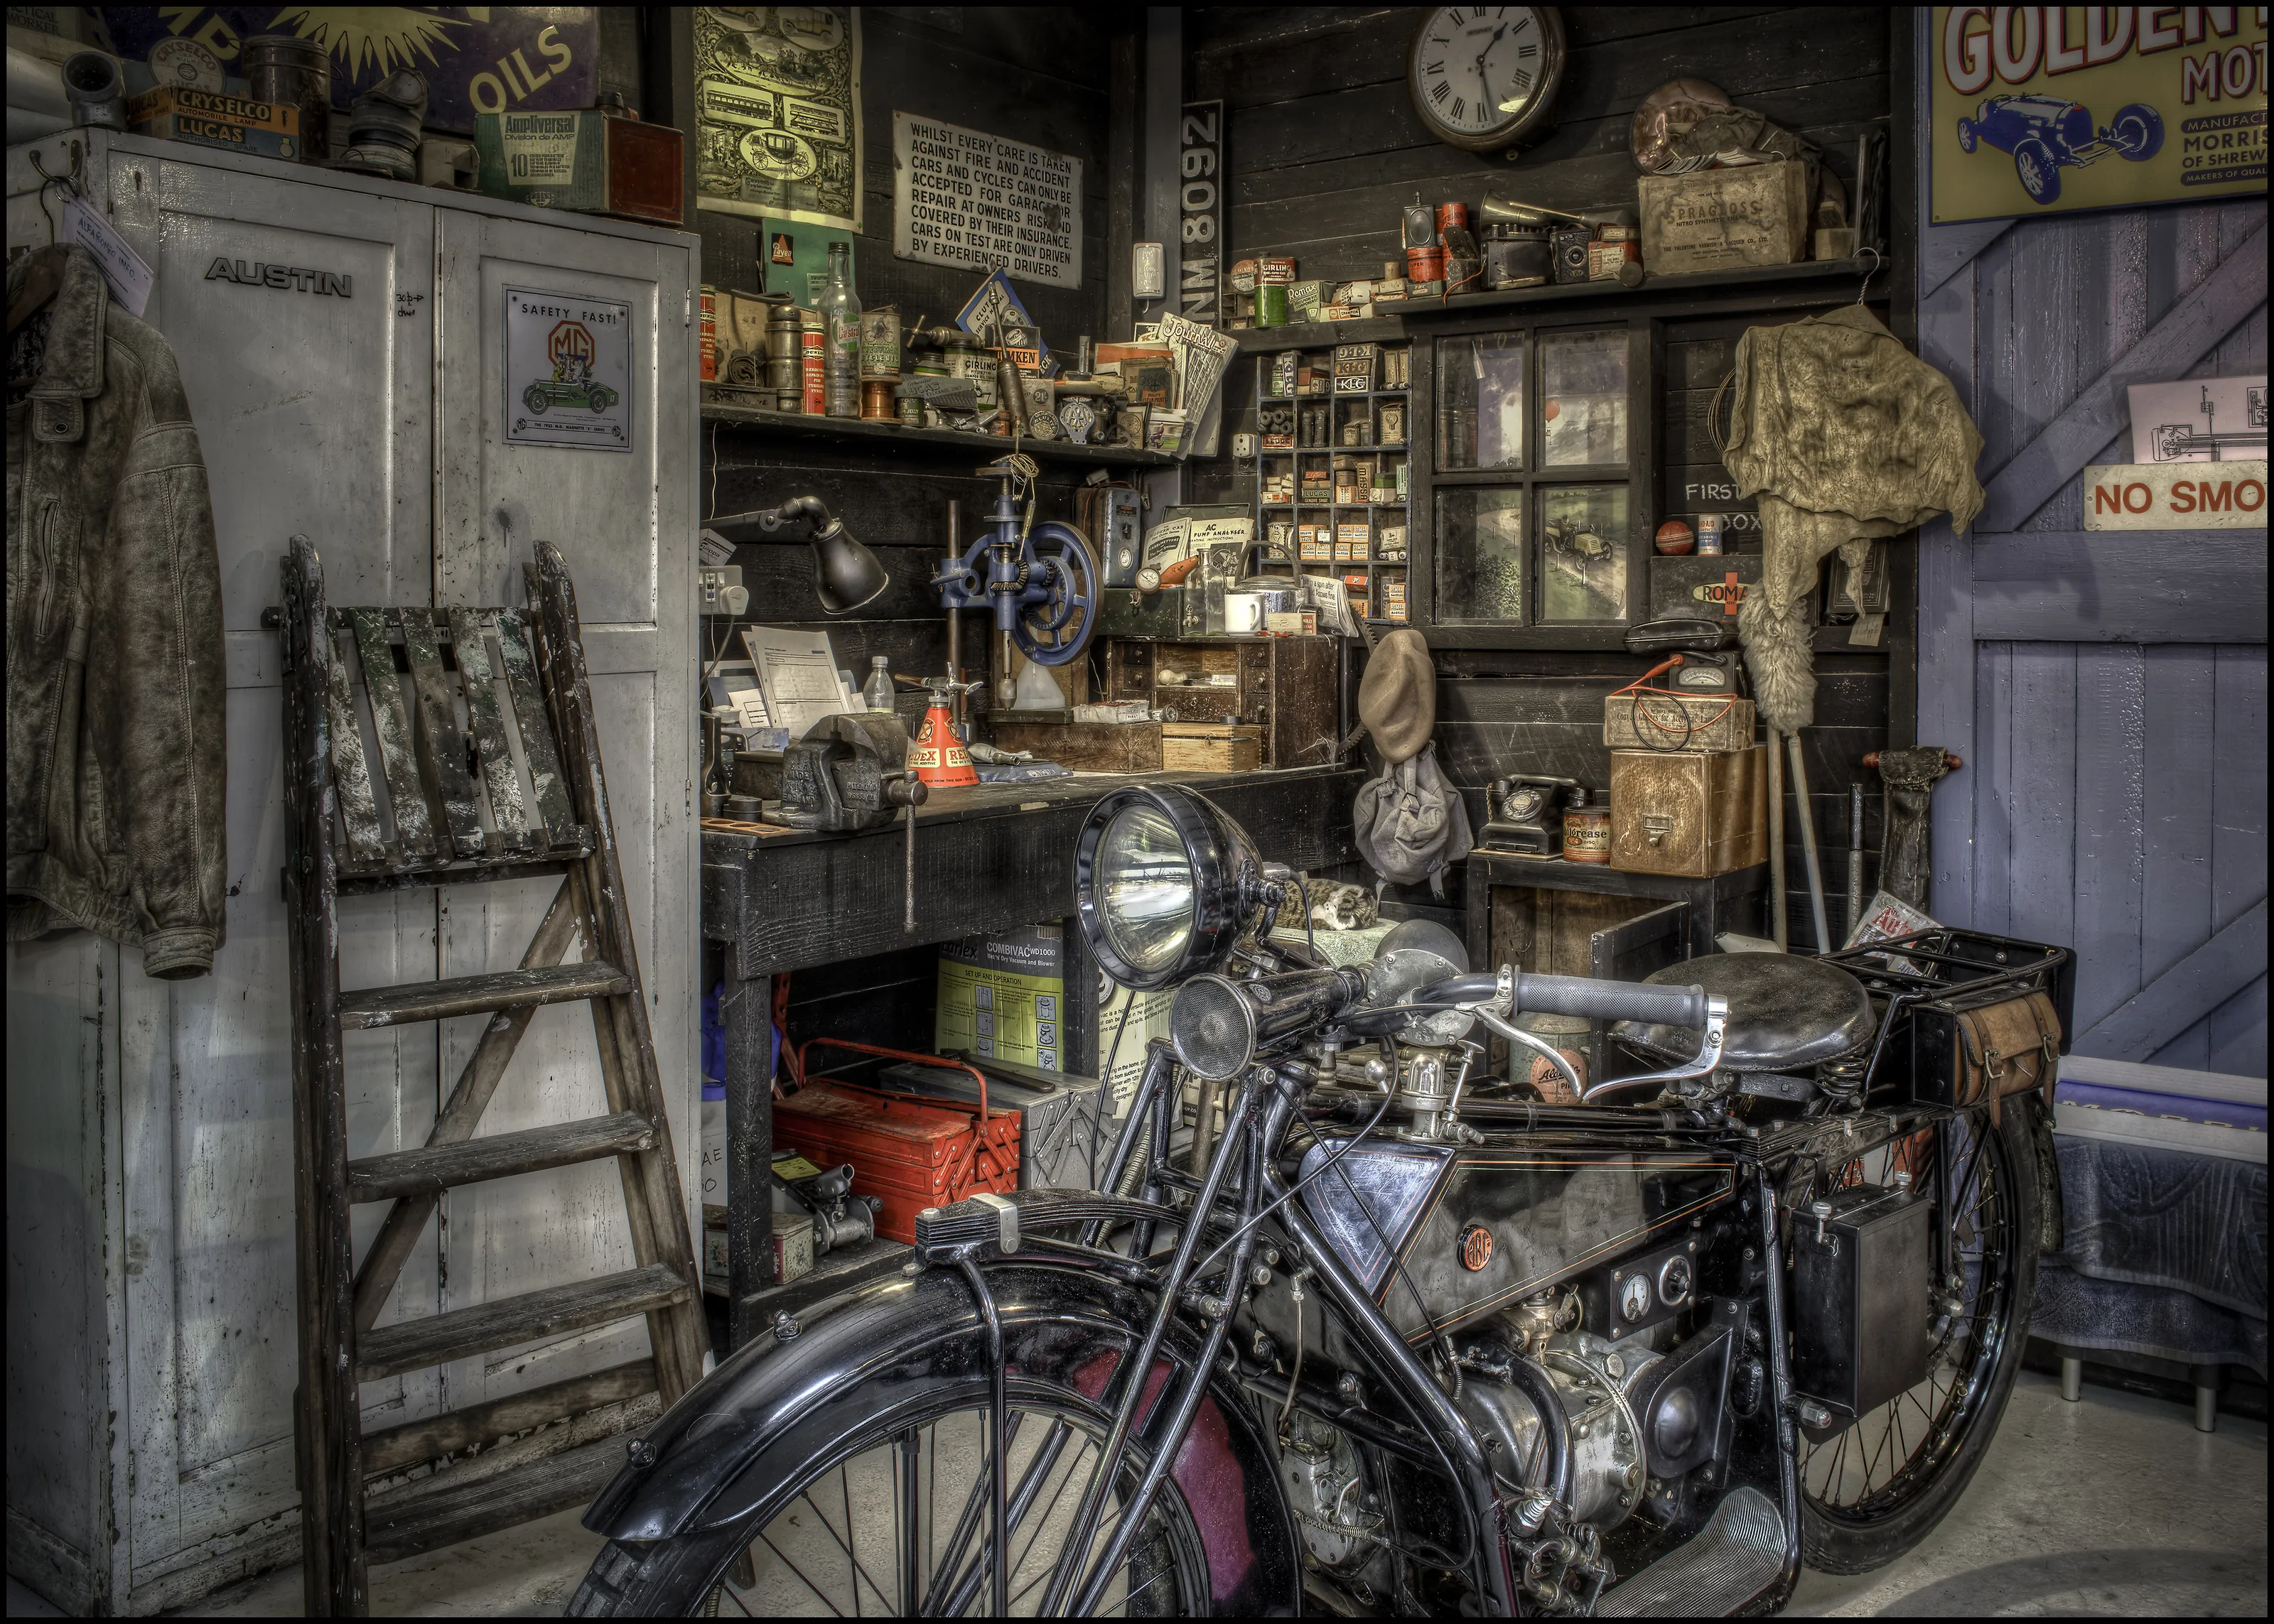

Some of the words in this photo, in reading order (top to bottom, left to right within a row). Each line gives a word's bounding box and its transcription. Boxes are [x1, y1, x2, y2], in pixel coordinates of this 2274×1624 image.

[156, 41, 217, 71] CRYSELCO
[469, 25, 571, 114] OILS
[178, 107, 227, 121] AUTOMOBILE
[179, 91, 270, 120] CRYSELCO
[180, 117, 243, 141] LUCAS
[505, 115, 574, 133] Ampliversal
[2188, 112, 2268, 131] MANUFACT
[178, 133, 228, 147] AUTHORISED
[234, 144, 258, 152] SPARE
[911, 122, 953, 144] WHILST
[959, 135, 993, 153] EVERY
[997, 144, 1025, 161] CARE
[1029, 152, 1038, 165] IS
[1041, 156, 1071, 174] TAKEN
[511, 154, 527, 177] 10
[912, 139, 959, 162] AGAINST
[966, 152, 991, 169] FIRE
[997, 159, 1018, 175] AND
[1023, 167, 1070, 189] ACCIDENT
[2182, 157, 2202, 168] OF
[2187, 172, 2223, 182] MAKERS
[2226, 170, 2238, 179] OF
[2241, 168, 2267, 178] QUAL
[912, 156, 942, 173] CARS
[947, 164, 969, 179] AND
[974, 170, 1013, 190] CYCLES
[1018, 180, 1036, 195] CAN
[1038, 186, 1060, 201] ONLY
[1061, 191, 1071, 204] BE
[1182, 112, 1216, 244] 8092
[912, 172, 972, 195] ACCEPTED
[980, 187, 1001, 203] FOR
[1008, 194, 1052, 212] GARAG
[912, 188, 957, 210] REPAIR
[961, 200, 974, 213] AT
[978, 203, 1020, 223] OWNERS
[1667, 200, 1760, 224] SPRAGLOSS
[78, 217, 95, 239] ALFA
[912, 205, 965, 227] COVERED
[970, 217, 982, 231] BY
[986, 220, 1013, 237] THEIR
[1017, 227, 1072, 249] INSURANCE.
[772, 242, 792, 257] Payen
[912, 222, 941, 238] CARS
[946, 229, 961, 242] ON
[966, 232, 991, 248] TEST
[993, 239, 1012, 253] ARE
[1015, 243, 1037, 257] ONLY
[1040, 248, 1070, 264] DRIVEN
[912, 238, 929, 253] BY
[934, 242, 1009, 268] EXPERIENCED
[1015, 258, 1061, 278] DRIVERS.
[205, 257, 352, 297] AUSTIN
[1182, 259, 1216, 320] NM
[1287, 283, 1317, 301] Remax
[522, 303, 569, 319] SAFETY
[583, 311, 617, 324] FAST!
[976, 315, 990, 334] SERVICE
[555, 327, 590, 356] MG
[838, 323, 860, 341] Castrol
[1163, 318, 1215, 349] Journal
[965, 361, 996, 370] GIRLING
[1685, 484, 1741, 500] FIRST
[2095, 482, 2152, 514] NO
[2170, 480, 2265, 513] SMO
[993, 975, 1021, 985] OPERATION
[1468, 1231, 1491, 1269] ABC
